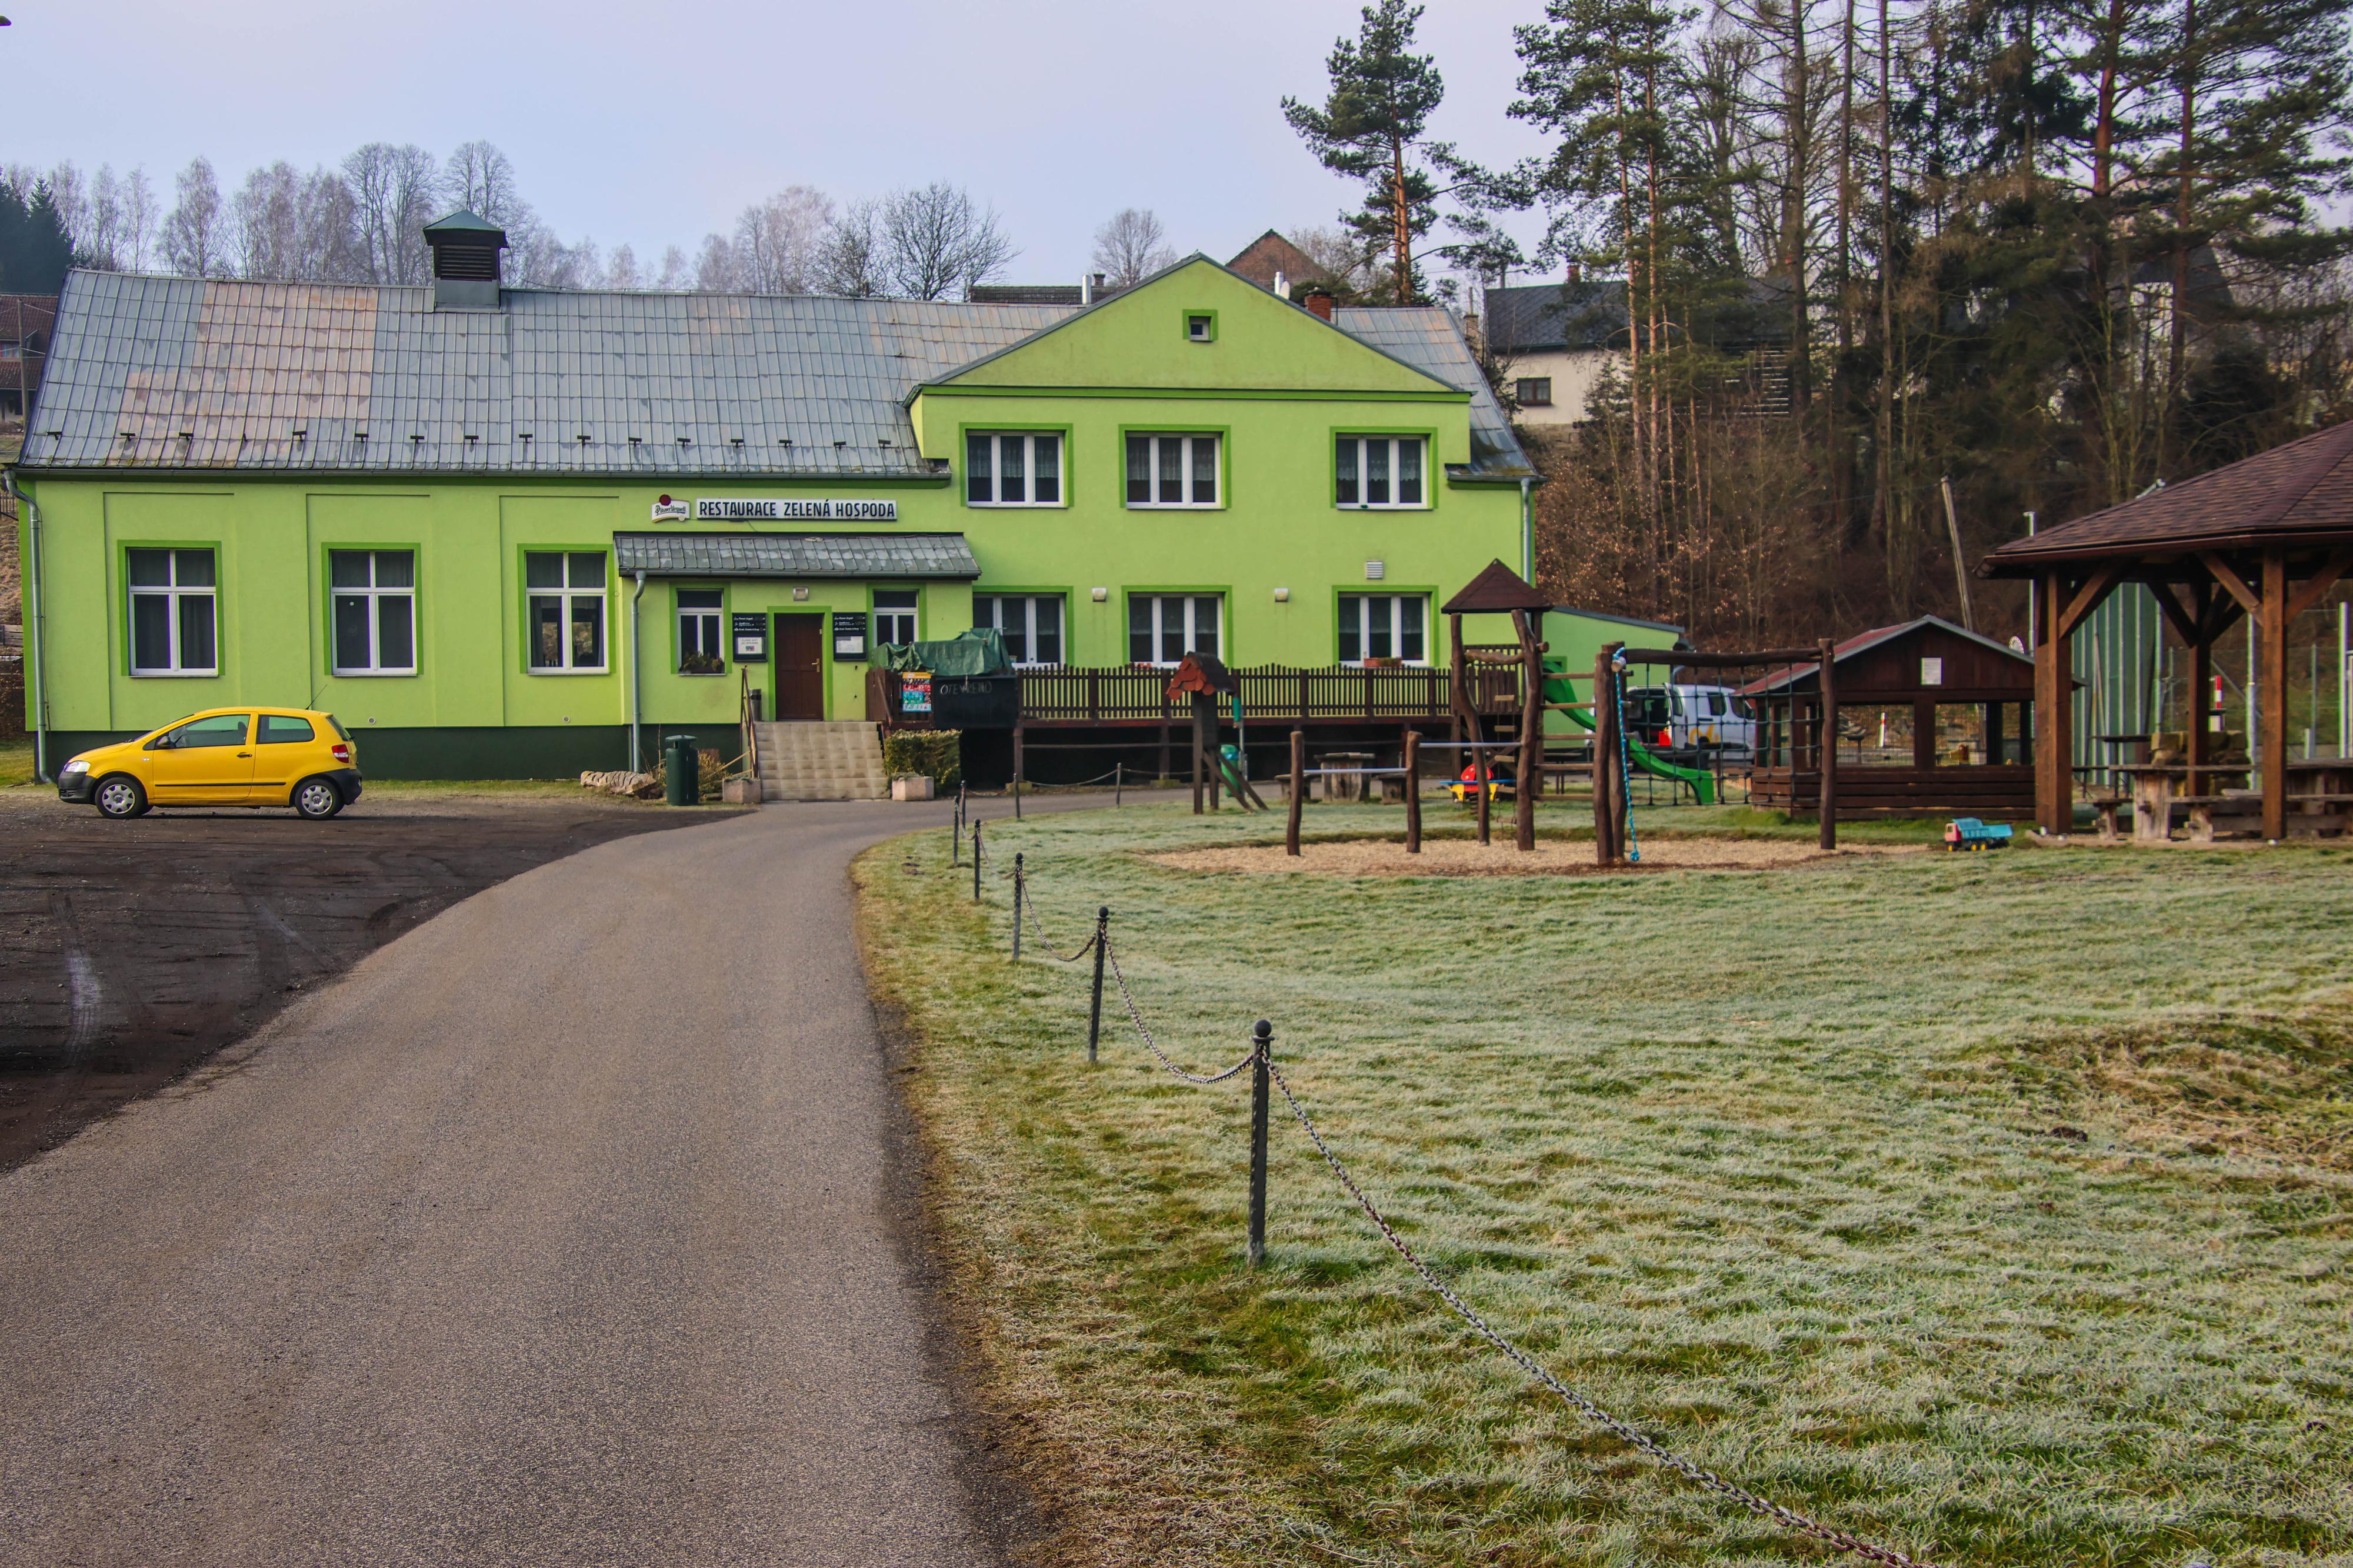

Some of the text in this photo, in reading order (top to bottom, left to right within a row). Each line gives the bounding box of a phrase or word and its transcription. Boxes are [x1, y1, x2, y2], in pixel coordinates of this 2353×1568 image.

[655, 505, 671, 516] Pilsner
[699, 499, 895, 517] RESTAURACE ZELENÁ HOSPODA
